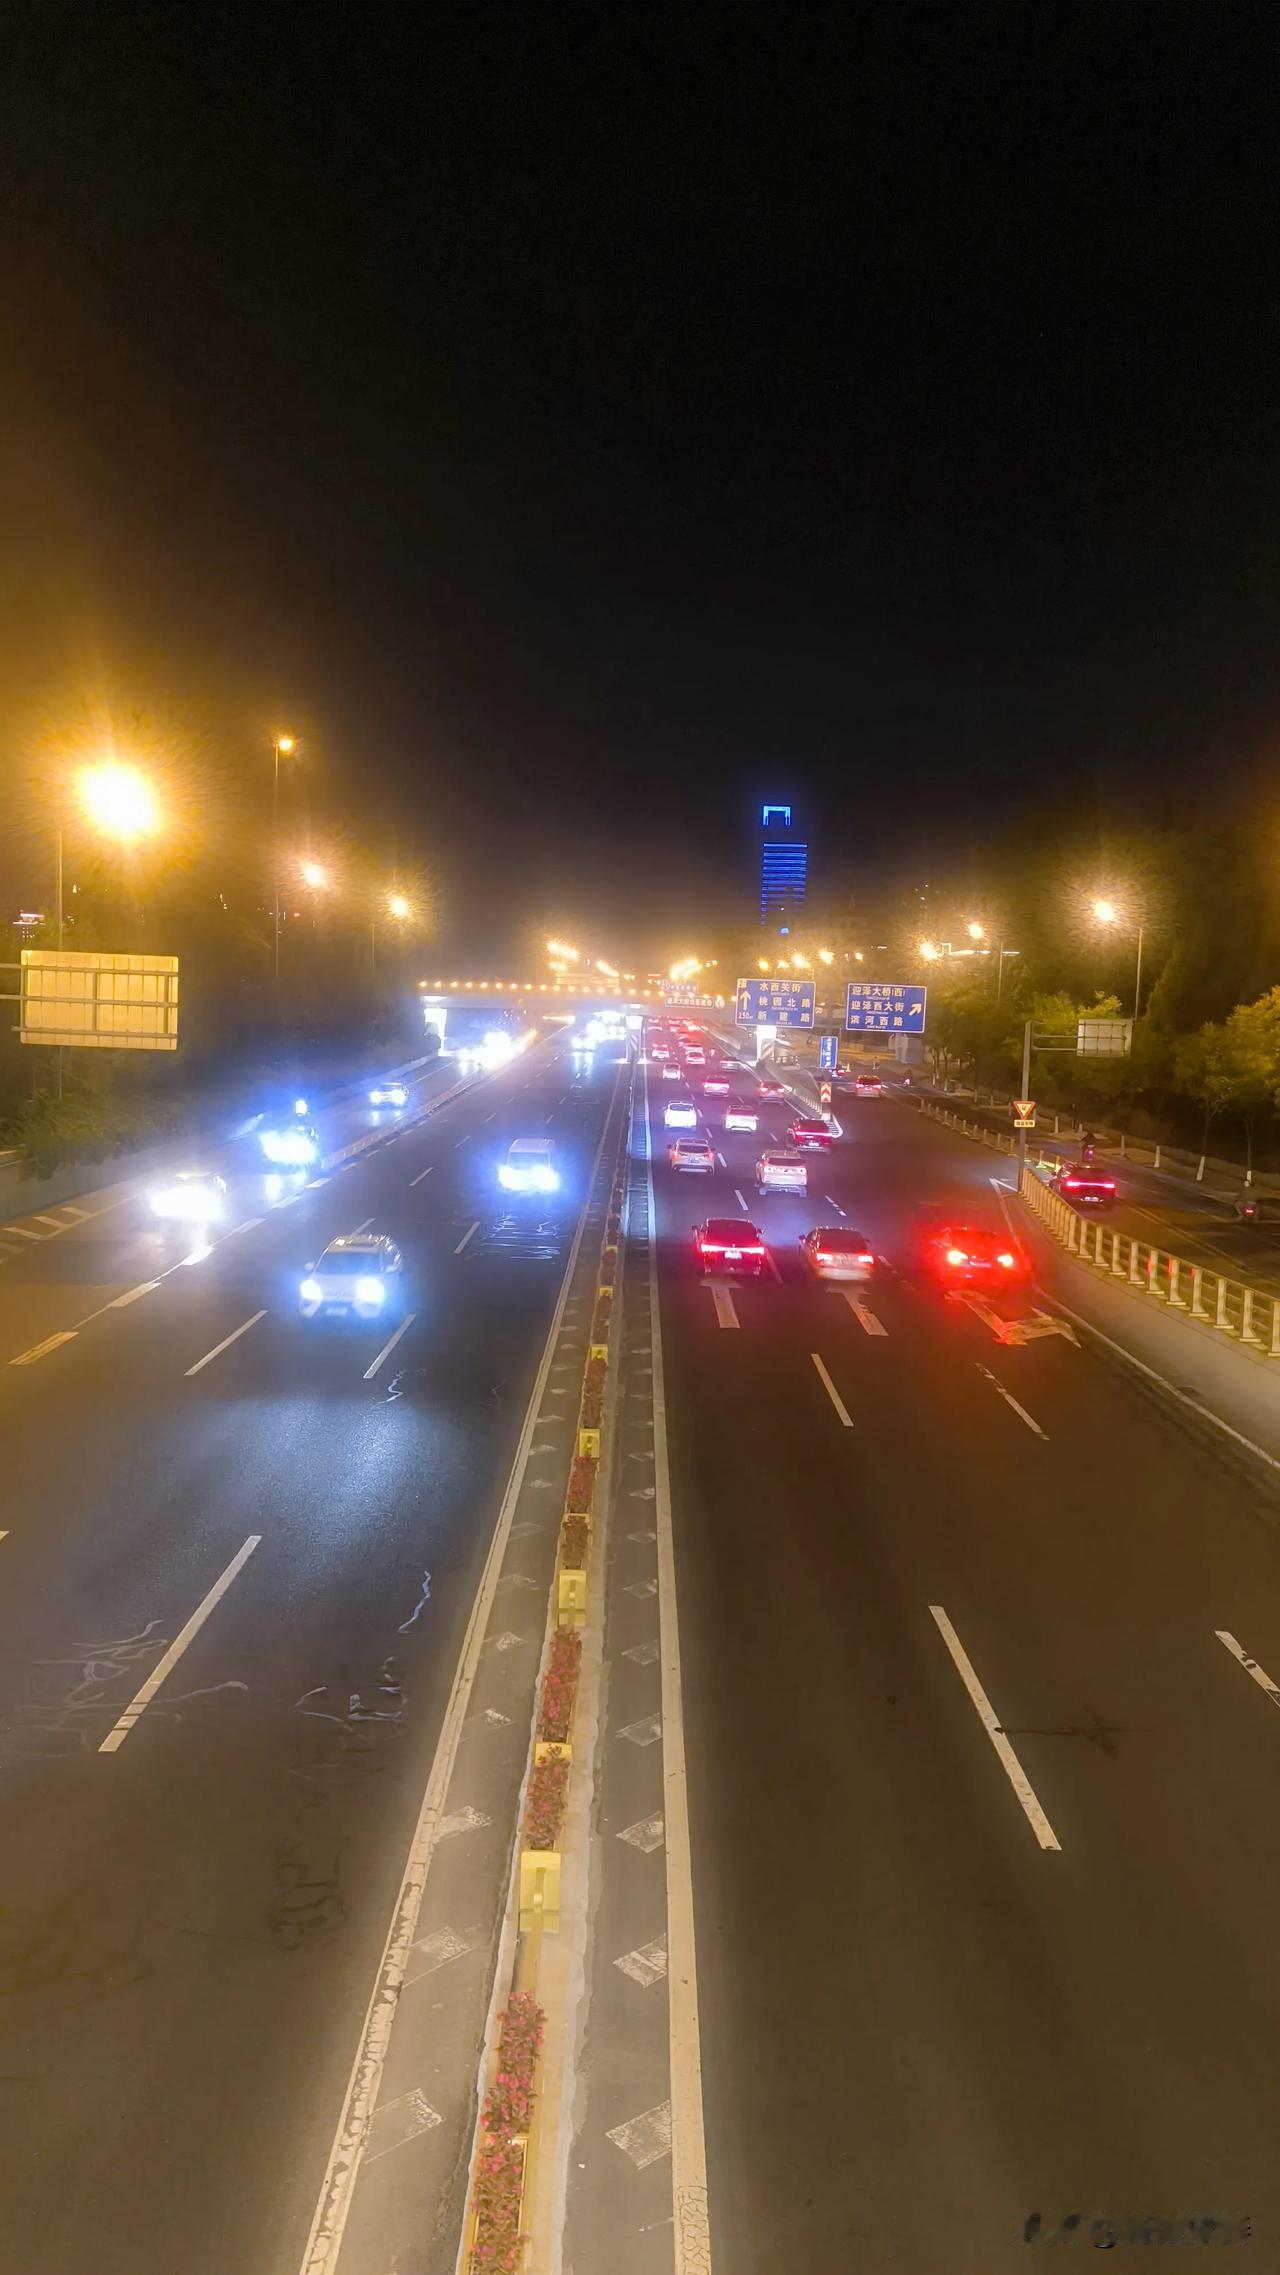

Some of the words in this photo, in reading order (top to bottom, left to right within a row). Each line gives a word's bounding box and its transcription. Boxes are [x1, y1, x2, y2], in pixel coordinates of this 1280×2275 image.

[760, 982, 801, 993] 水西关街
[759, 996, 811, 1008] 桃园北路
[851, 1001, 904, 1012] 迎泽西大街
[850, 1015, 903, 1026] 滨河西路
